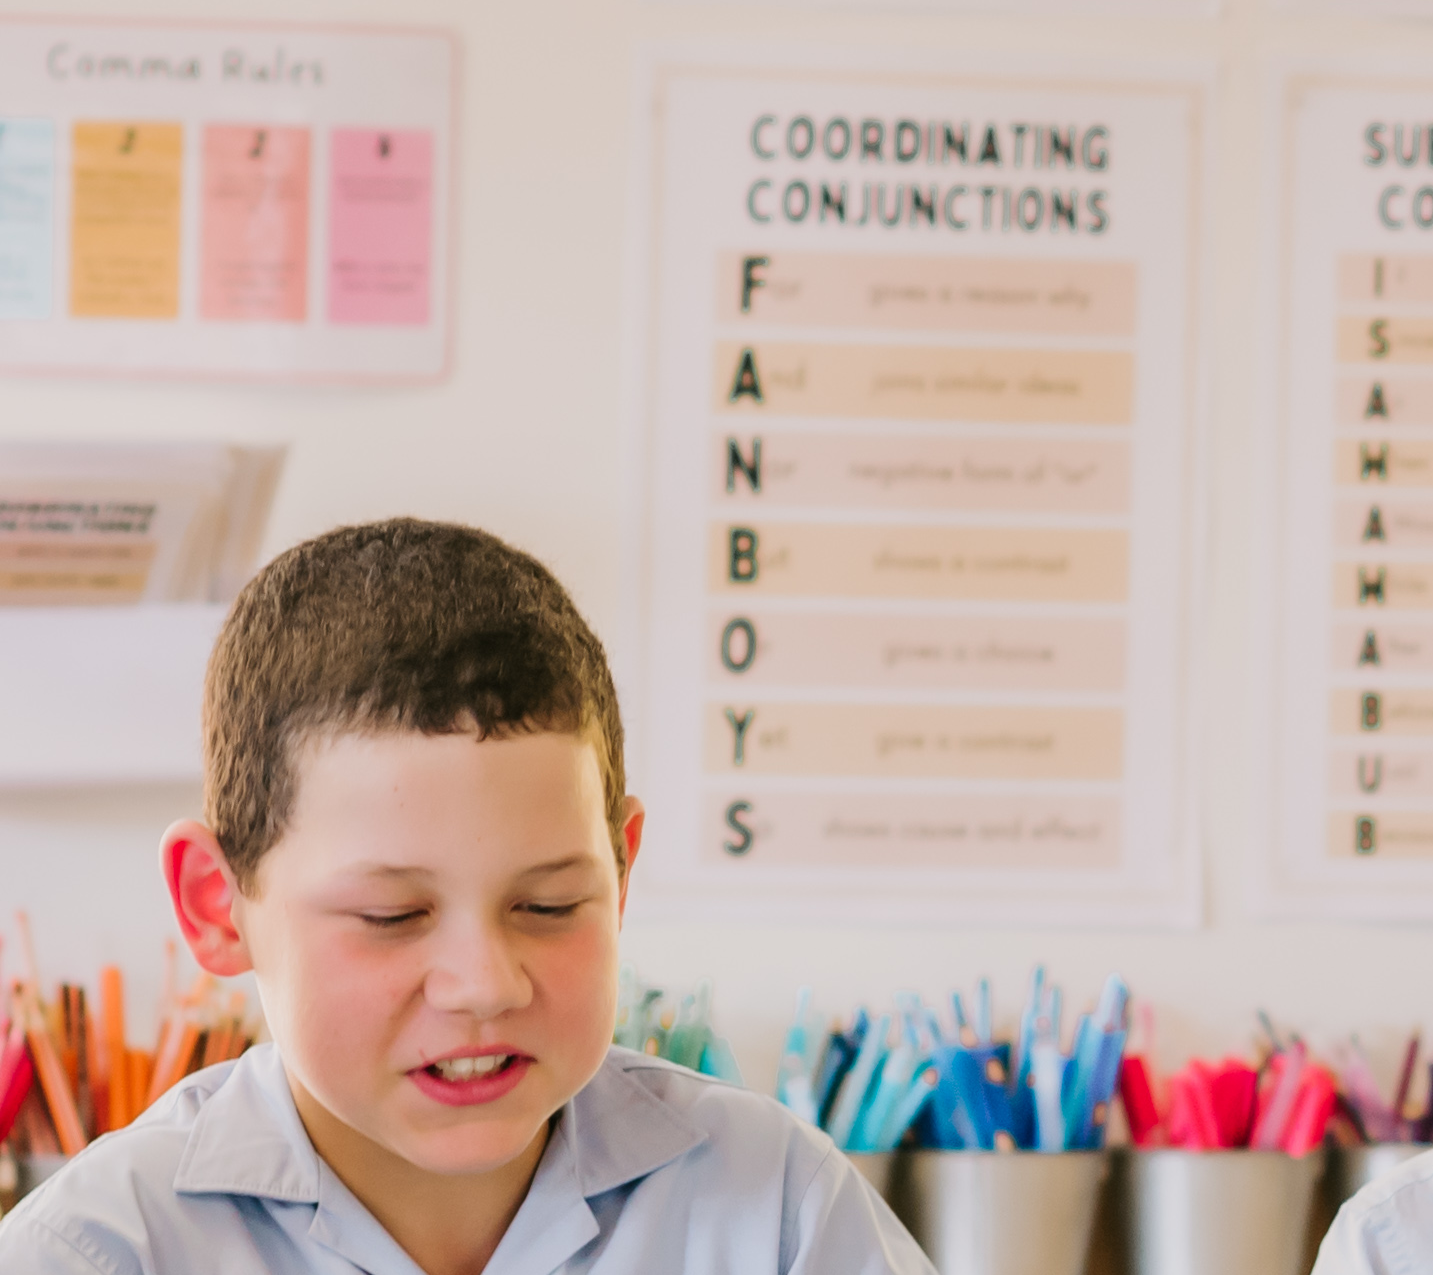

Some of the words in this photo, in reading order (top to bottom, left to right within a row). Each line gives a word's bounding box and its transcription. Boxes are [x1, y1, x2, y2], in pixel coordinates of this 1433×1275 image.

[46, 43, 200, 82] Comma
[221, 48, 324, 86] Rules
[750, 115, 1110, 172] COORDINATING
[746, 179, 1110, 234] CONJUNCTIONS
